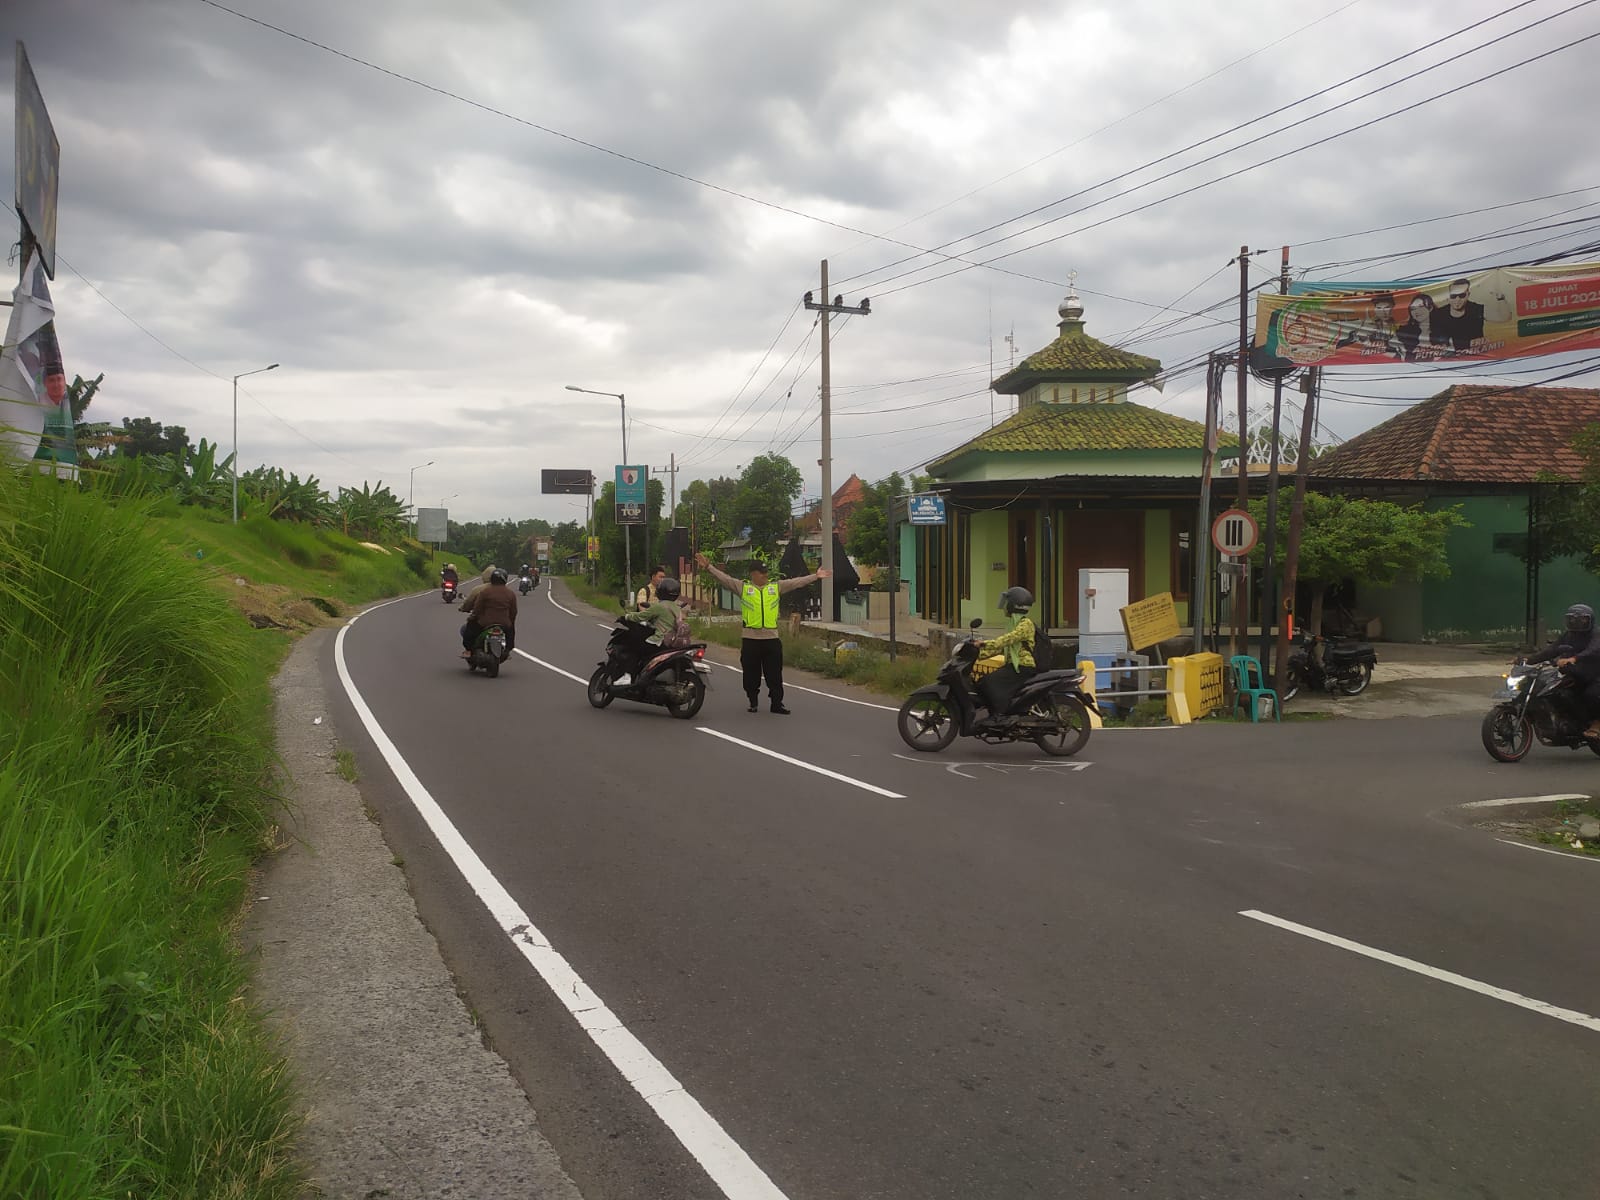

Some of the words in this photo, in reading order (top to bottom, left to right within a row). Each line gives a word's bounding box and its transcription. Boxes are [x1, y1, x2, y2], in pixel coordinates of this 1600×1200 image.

[1548, 284, 1578, 294] JUMAT
[1524, 300, 1538, 310] 18
[1541, 295, 1568, 308] JULI
[620, 508, 642, 517] TOP
